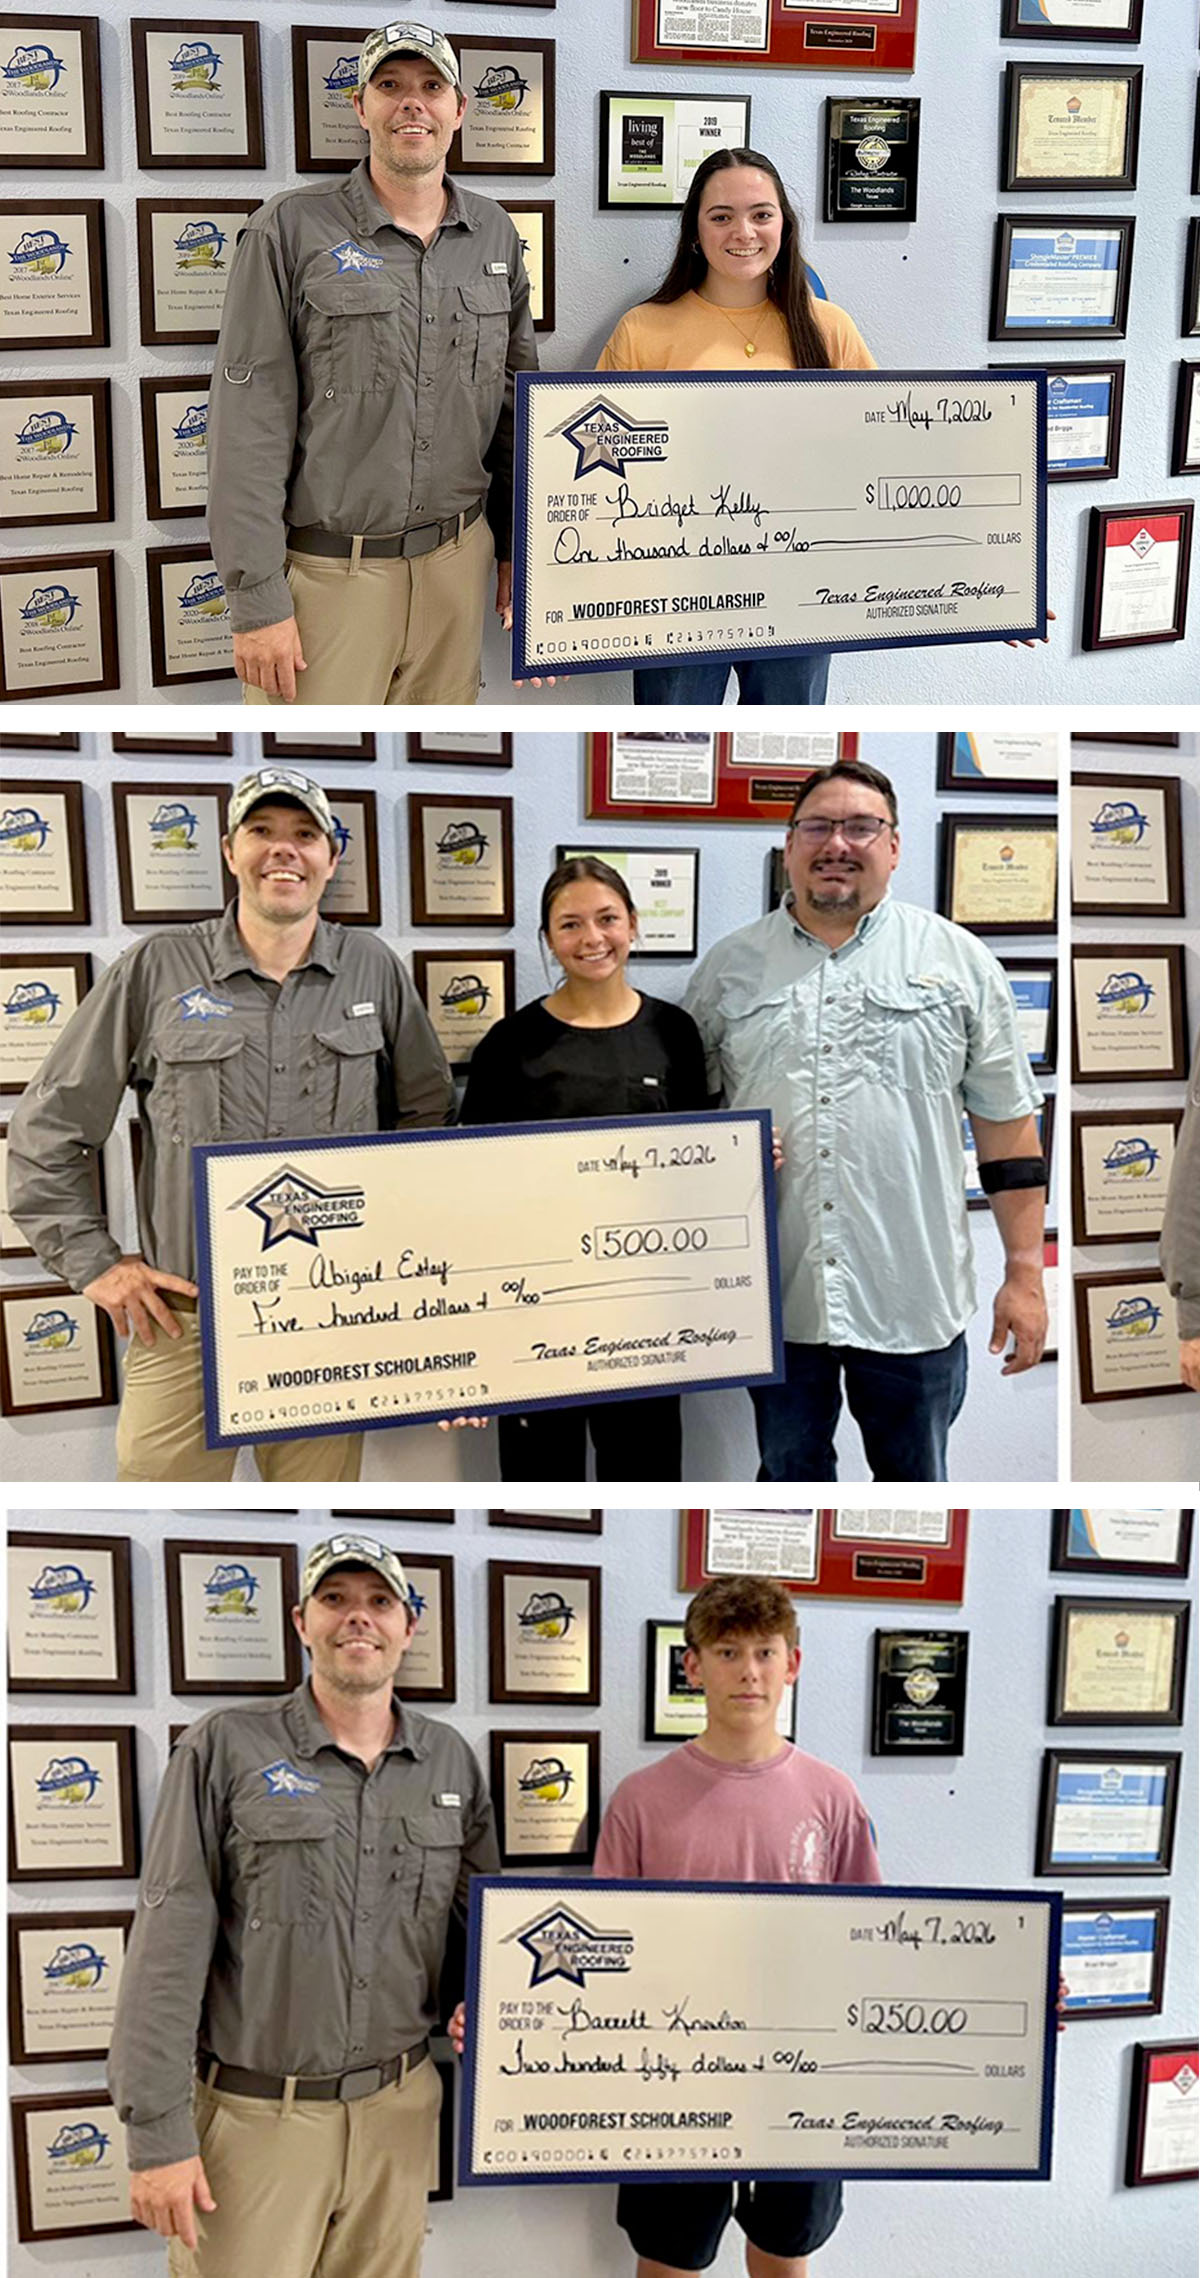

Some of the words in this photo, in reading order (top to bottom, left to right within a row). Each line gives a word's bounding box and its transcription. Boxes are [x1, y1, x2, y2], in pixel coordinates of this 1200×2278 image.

[868, 116, 900, 124] Engineered
[628, 119, 658, 137] living
[699, 128, 721, 137] WINNER
[631, 138, 645, 146] best
[646, 139, 654, 148] of
[1010, 395, 1016, 406] 1
[865, 412, 885, 423] DATE
[886, 390, 933, 430] May
[584, 422, 620, 433] TEXAS
[596, 433, 669, 445] ENGINEERED
[611, 446, 662, 458] ROOFING
[547, 495, 565, 508] PAY
[567, 494, 579, 506] TO
[580, 493, 598, 505] THE
[865, 483, 875, 504] $
[885, 482, 961, 511] 1,000.00
[605, 483, 700, 528] Bridget
[711, 485, 769, 527] Kelly
[547, 510, 577, 523] ORDER
[578, 509, 589, 521] OF
[553, 526, 598, 564] One
[606, 537, 690, 561] thousand
[700, 536, 751, 556] dollars
[987, 533, 1022, 545] DOLLARS
[816, 588, 857, 605] Texas
[864, 585, 945, 603] Engineered
[950, 581, 1005, 598] Roofing
[573, 598, 668, 620] WOODFOREST
[672, 593, 765, 613] SCHOLARSHIP
[866, 605, 915, 620] AUTHORIZED
[916, 603, 958, 617] SIGNATURE
[546, 611, 563, 624] FOR
[577, 1161, 600, 1173] DATE
[270, 1191, 309, 1202] TEXAS
[284, 1199, 365, 1214] ENGINEERED
[301, 1212, 359, 1226] ROOFING
[580, 1234, 592, 1255] $
[602, 1227, 708, 1258] 500.00
[233, 1267, 253, 1280] PAY
[255, 1265, 269, 1278] TO
[270, 1263, 288, 1276] THE
[308, 1254, 383, 1295] Abigail
[234, 1281, 268, 1295] ORDER
[269, 1280, 280, 1292] OF
[714, 1276, 752, 1290] DOLLARS
[252, 1296, 303, 1334] Five
[413, 1298, 471, 1320] dollars
[531, 1343, 576, 1360] Texas
[584, 1332, 672, 1356] Engineered
[678, 1328, 737, 1346] Roofing
[587, 1356, 639, 1372] AUTHORIZED
[641, 1351, 687, 1367] SIGNATURE
[267, 1362, 370, 1389] WOODFOREST
[375, 1351, 477, 1377] SCHOLARSHIP
[239, 1381, 259, 1394] FOR
[541, 1930, 580, 1941] TEXAS
[850, 1929, 873, 1941] DATE
[554, 1944, 634, 1954] ENGINEERED
[570, 1956, 625, 1966] ROOFING
[499, 2002, 520, 2015] PAY
[522, 2002, 535, 2014] TO
[535, 2002, 553, 2015] THE
[847, 2004, 858, 2027] $
[499, 2017, 532, 2030] ORDER
[533, 2018, 545, 2030] OF
[557, 1998, 651, 2040] Barrett
[867, 2004, 968, 2034] 250.00
[500, 2039, 549, 2075] Two
[692, 2053, 747, 2073] dollars
[984, 2065, 1026, 2078] DOLLARS
[495, 2120, 513, 2131] FOR
[523, 2112, 624, 2130] WOODFOREST
[630, 2112, 733, 2128] SCHOLARSHIP
[788, 2112, 834, 2130] Texas
[842, 2112, 932, 2132] Engineered
[940, 2114, 1004, 2136] Roofing
[844, 2136, 900, 2148] AUTHORIZED
[901, 2137, 949, 2148] SIGNATURE
